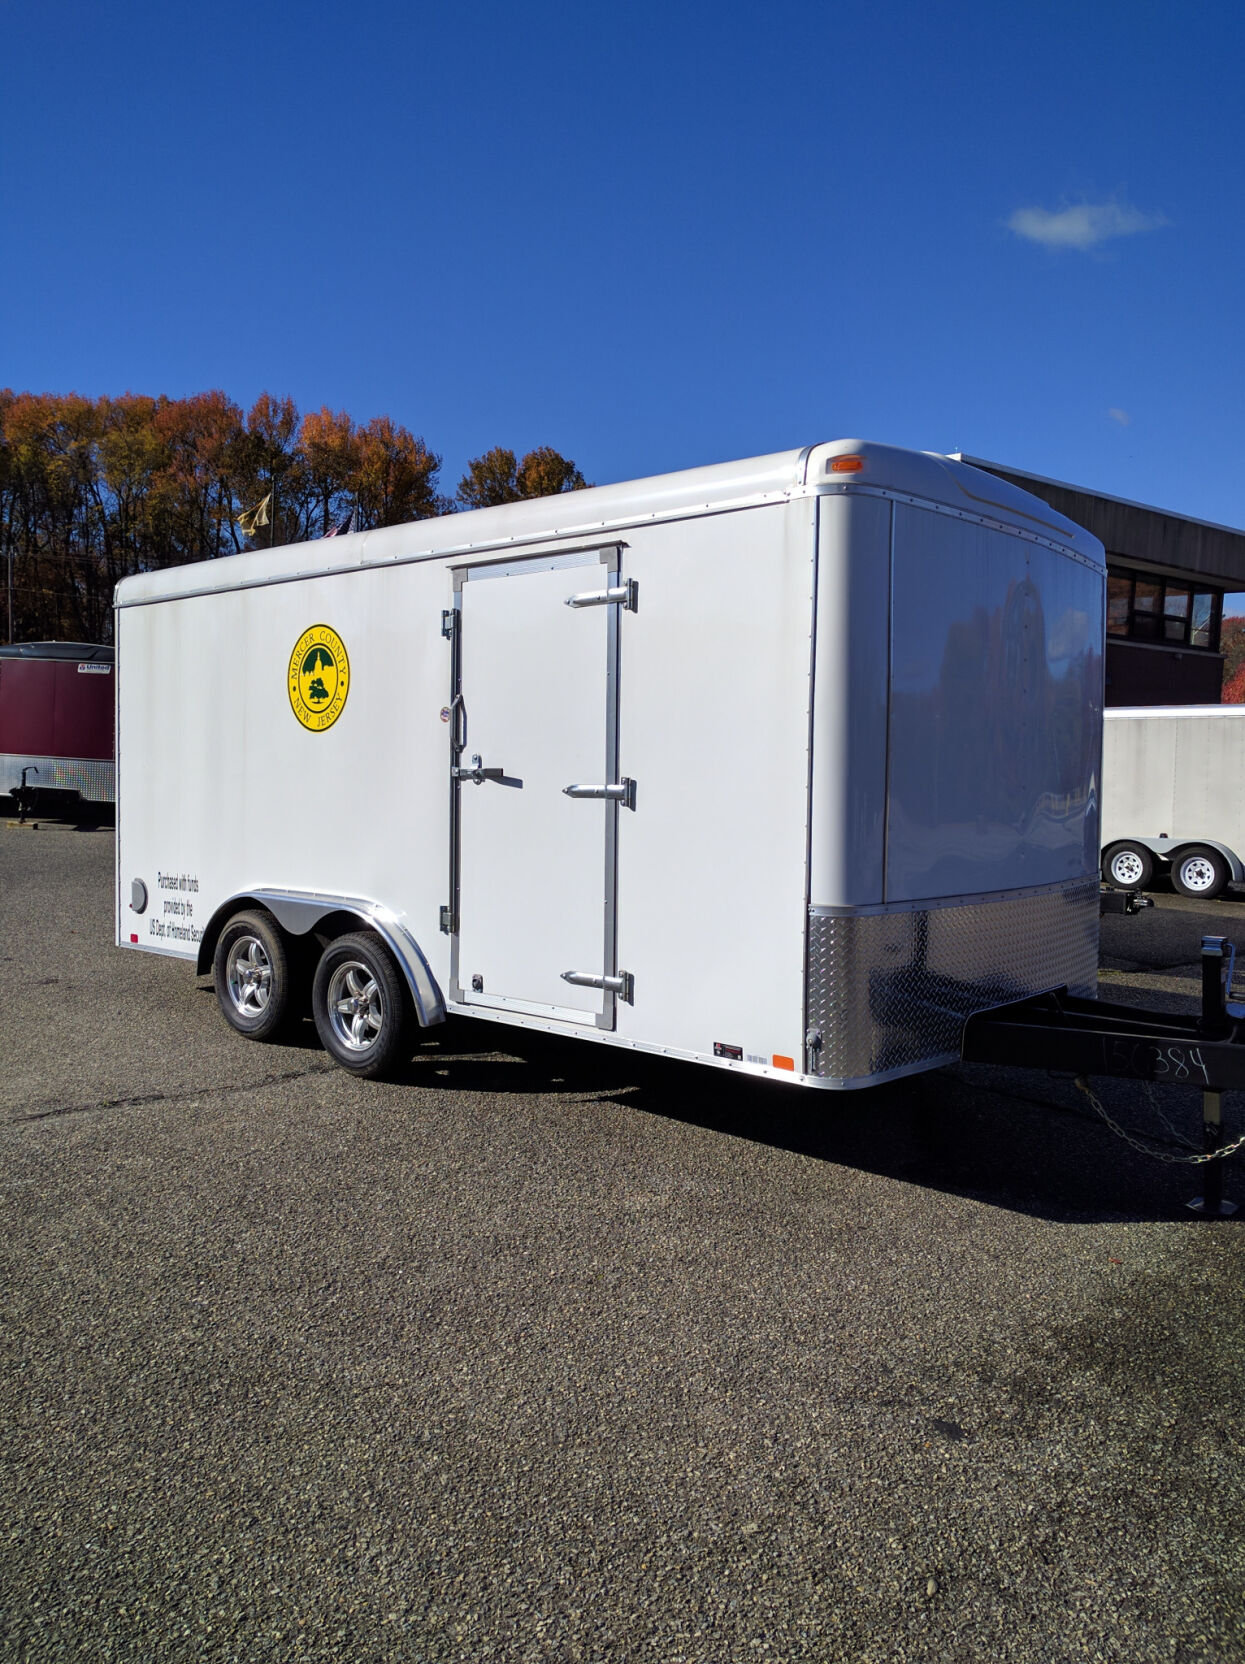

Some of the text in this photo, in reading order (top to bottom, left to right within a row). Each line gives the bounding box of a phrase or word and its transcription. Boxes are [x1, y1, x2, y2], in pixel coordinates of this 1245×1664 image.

[291, 631, 346, 680] MERCER COUNTY
[294, 692, 342, 727] NEW JERSEY
[158, 871, 199, 893] Purchased with funds
[164, 897, 180, 917] provided
[172, 921, 191, 941] Homeland
